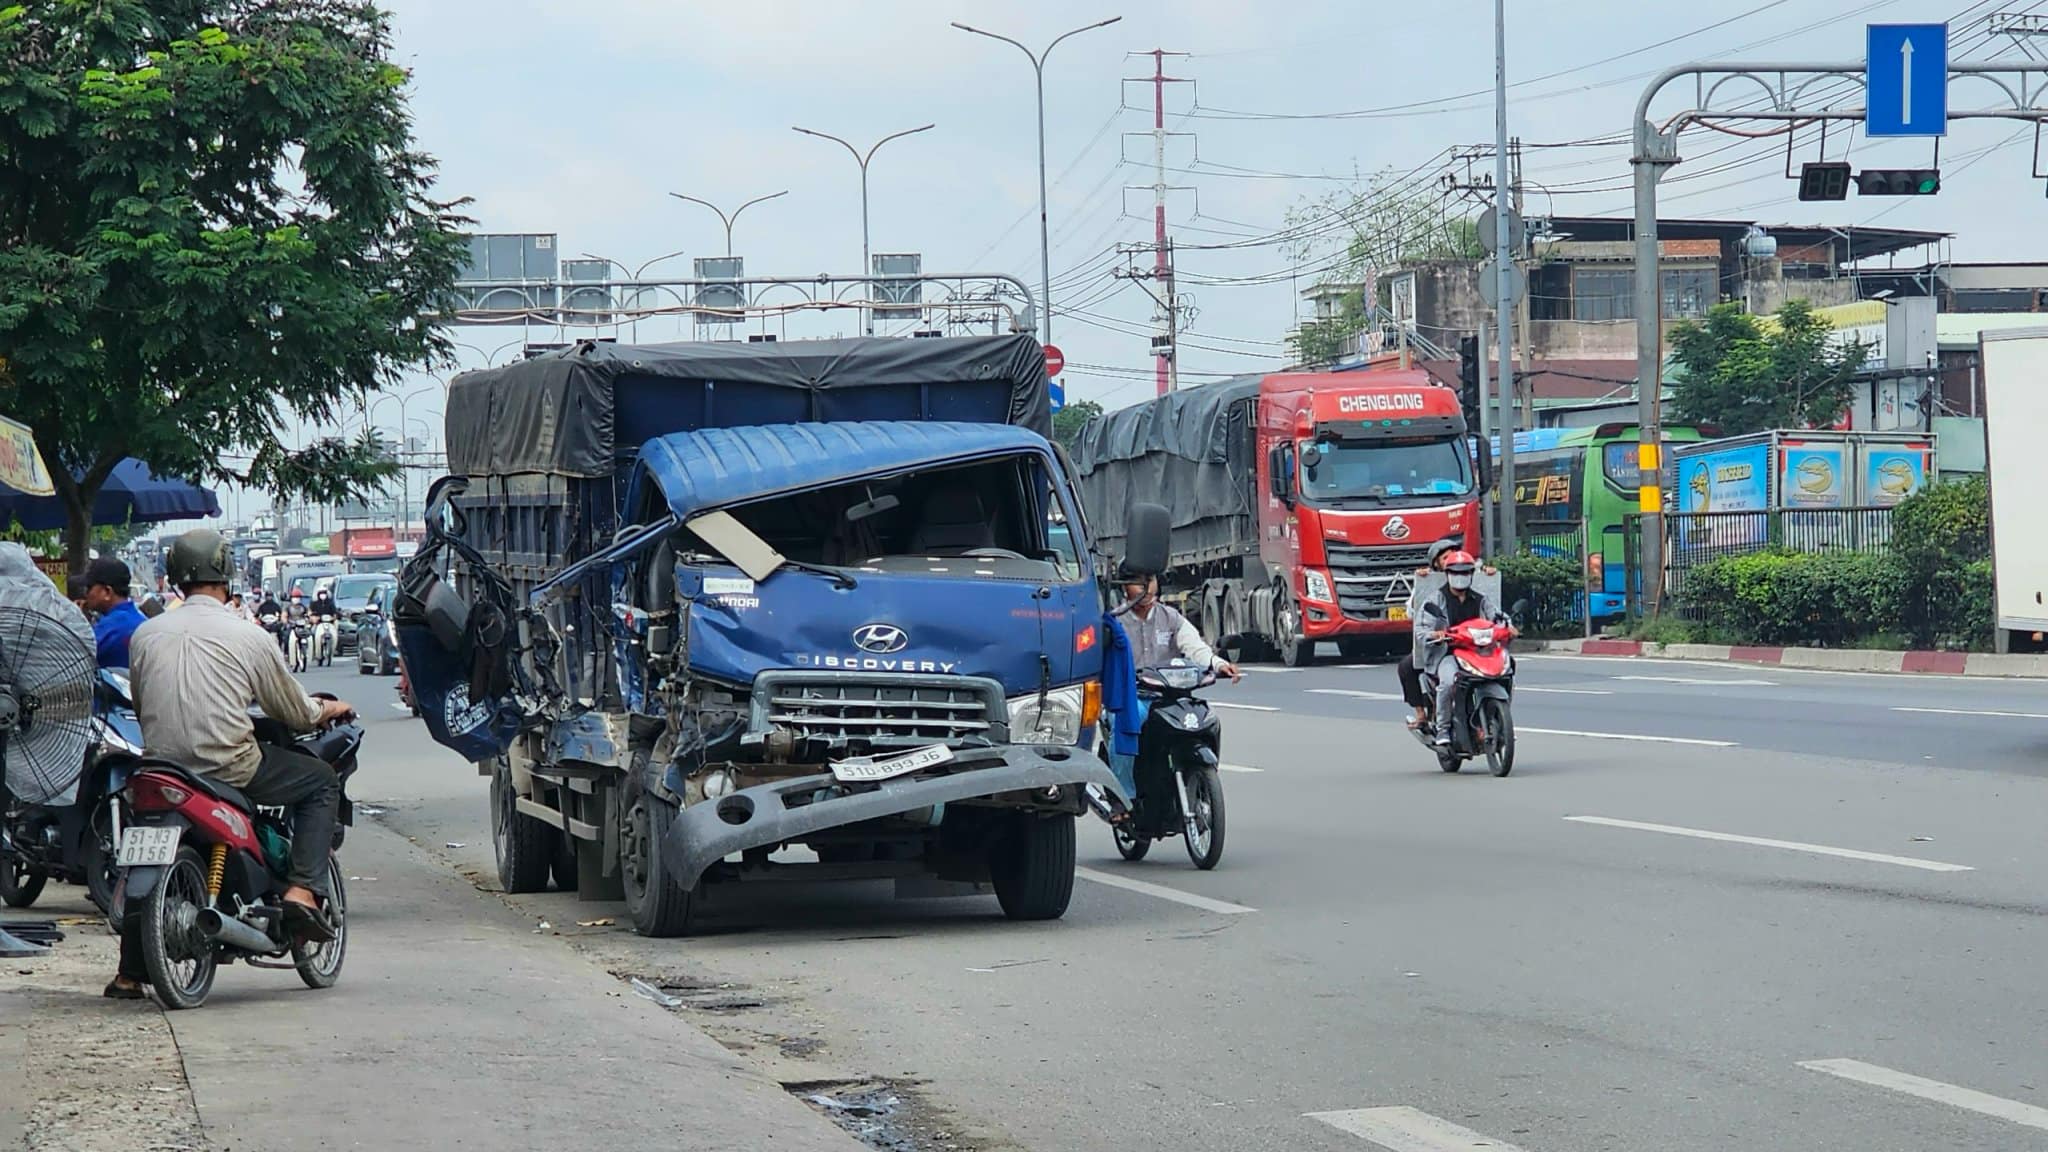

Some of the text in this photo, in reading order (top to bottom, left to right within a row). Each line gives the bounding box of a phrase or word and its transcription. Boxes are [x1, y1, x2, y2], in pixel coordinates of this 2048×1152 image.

[1339, 393, 1424, 412] CHENGLONG
[129, 829, 172, 845] 51-N3
[126, 845, 167, 862] 0156
